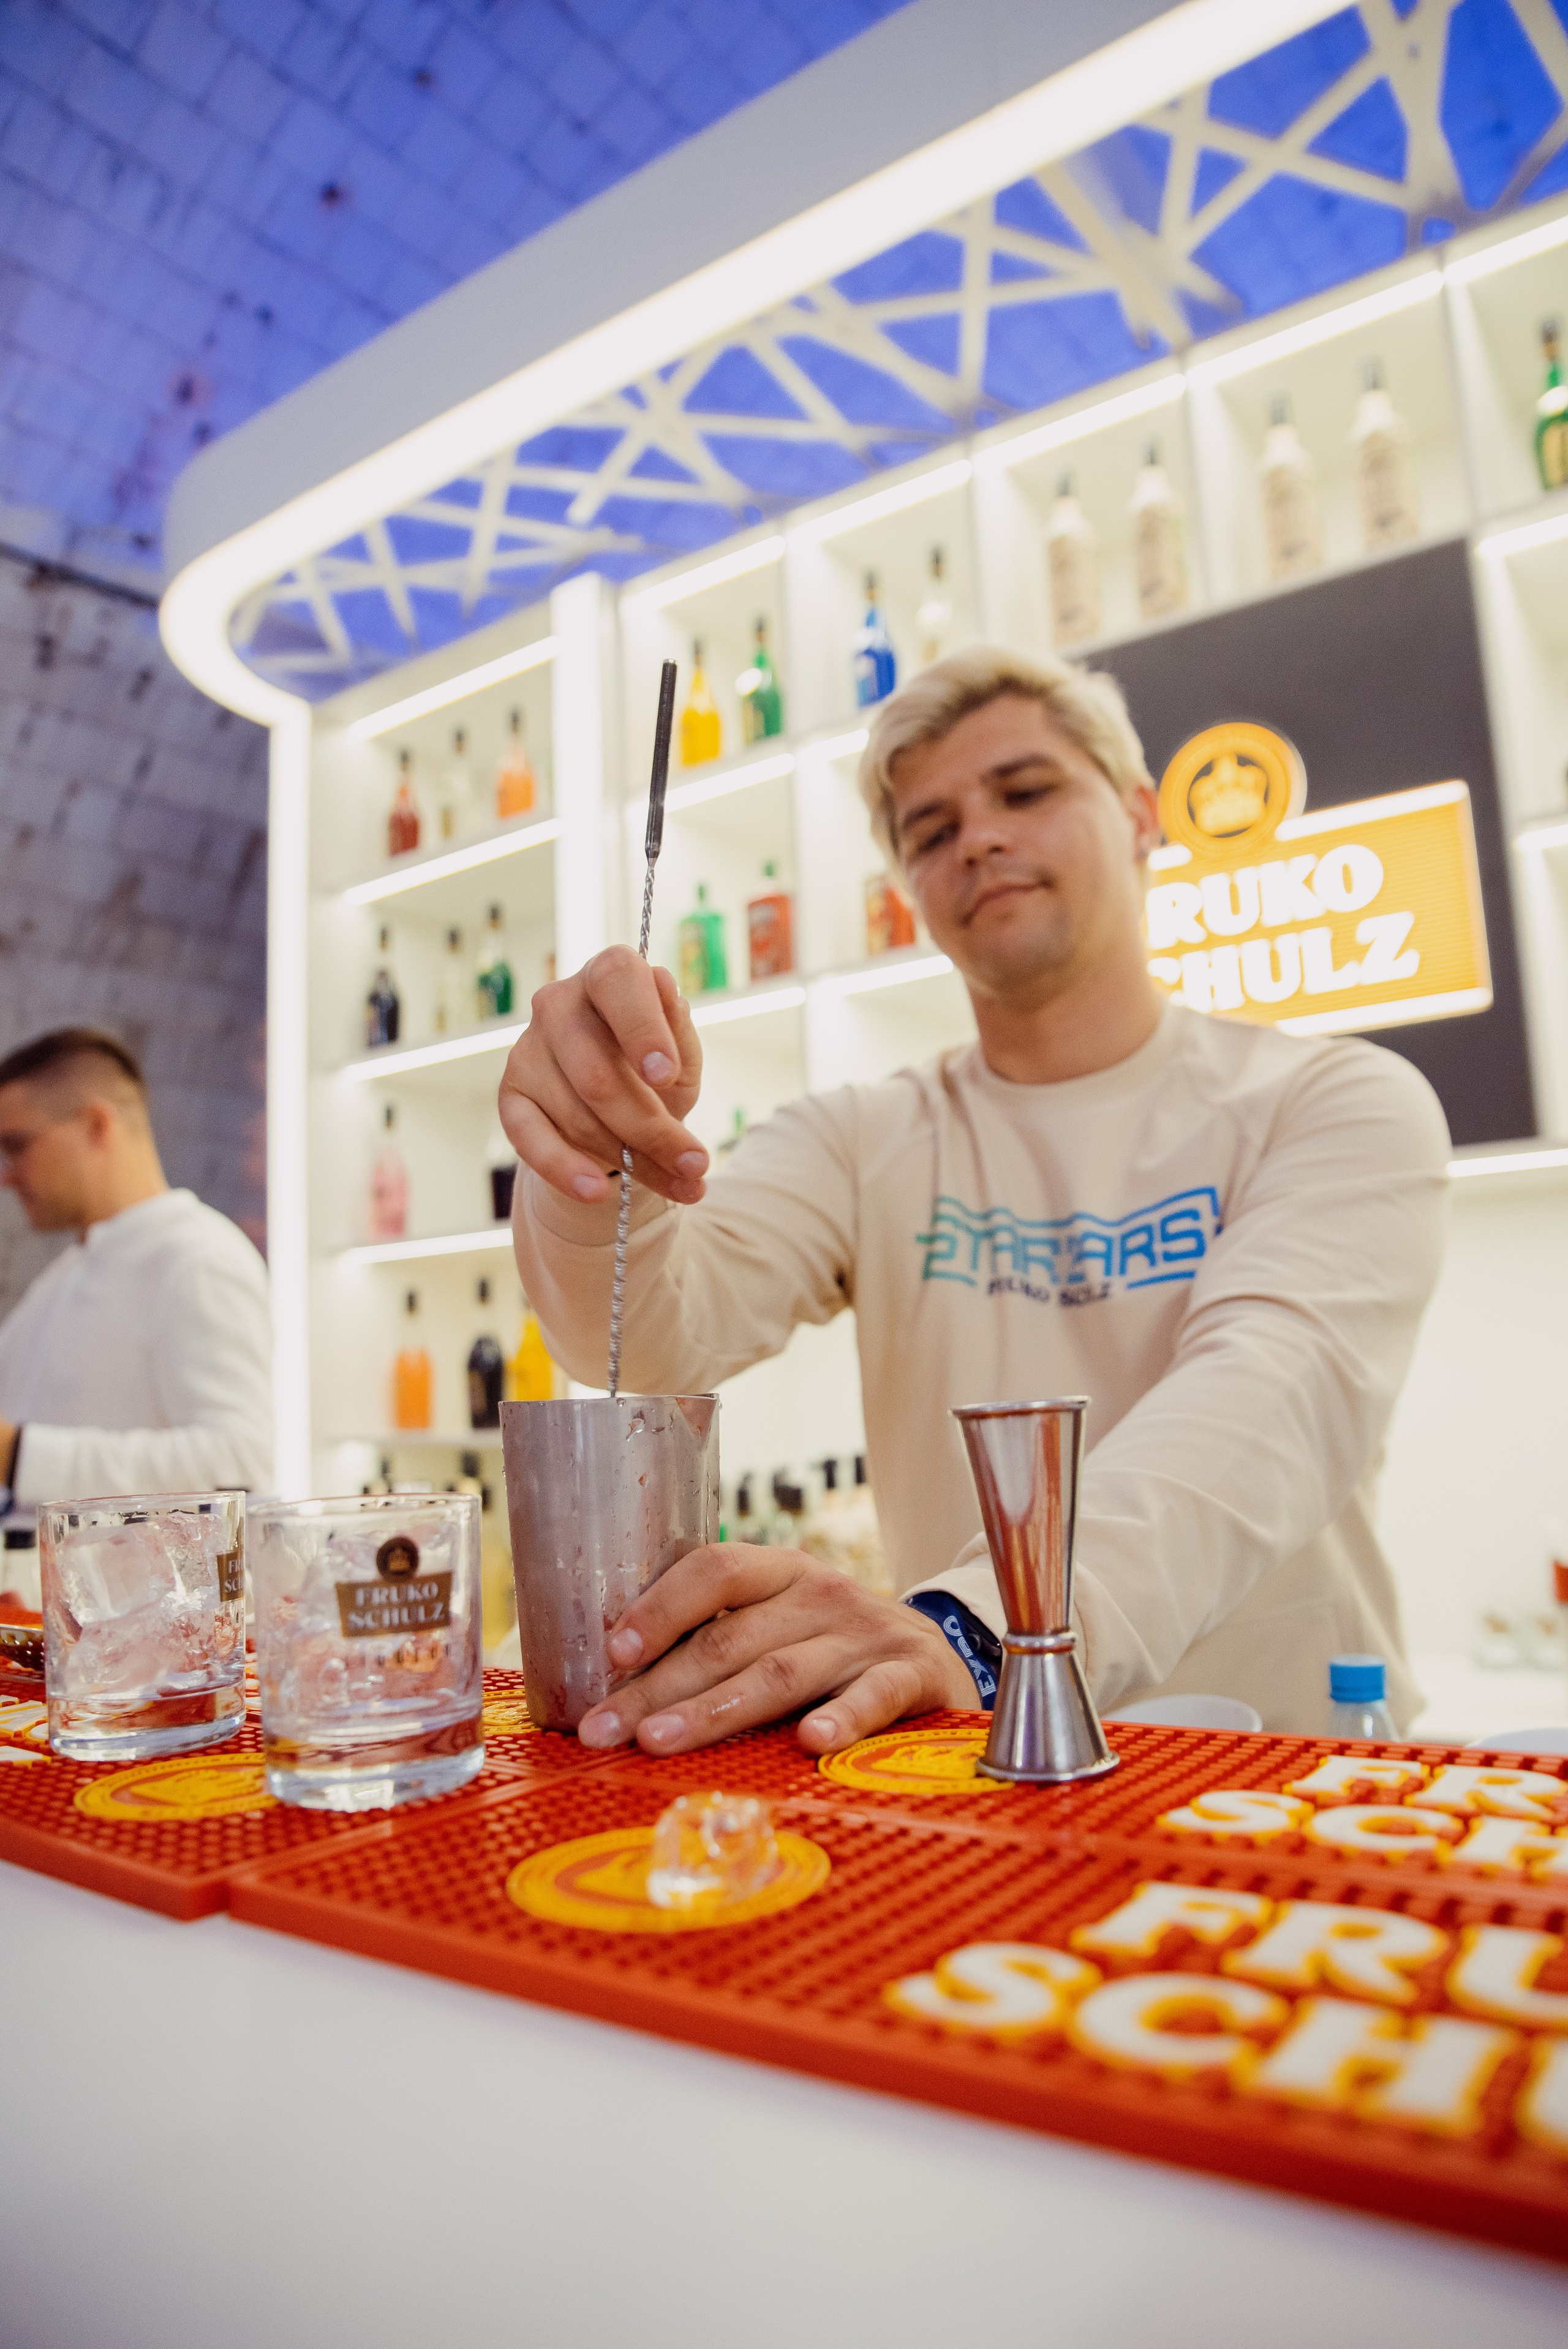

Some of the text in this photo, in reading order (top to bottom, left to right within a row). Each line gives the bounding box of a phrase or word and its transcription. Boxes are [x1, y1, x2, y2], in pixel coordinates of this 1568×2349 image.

[1145, 843, 1384, 951] RUKO
[1147, 911, 1420, 1014] HULZ
[348, 1602, 445, 1628] SCHULZ
[356, 1582, 439, 1607] FRUKO
[943, 1615, 997, 1697] EXPO
[883, 1942, 1568, 2156] SCH
